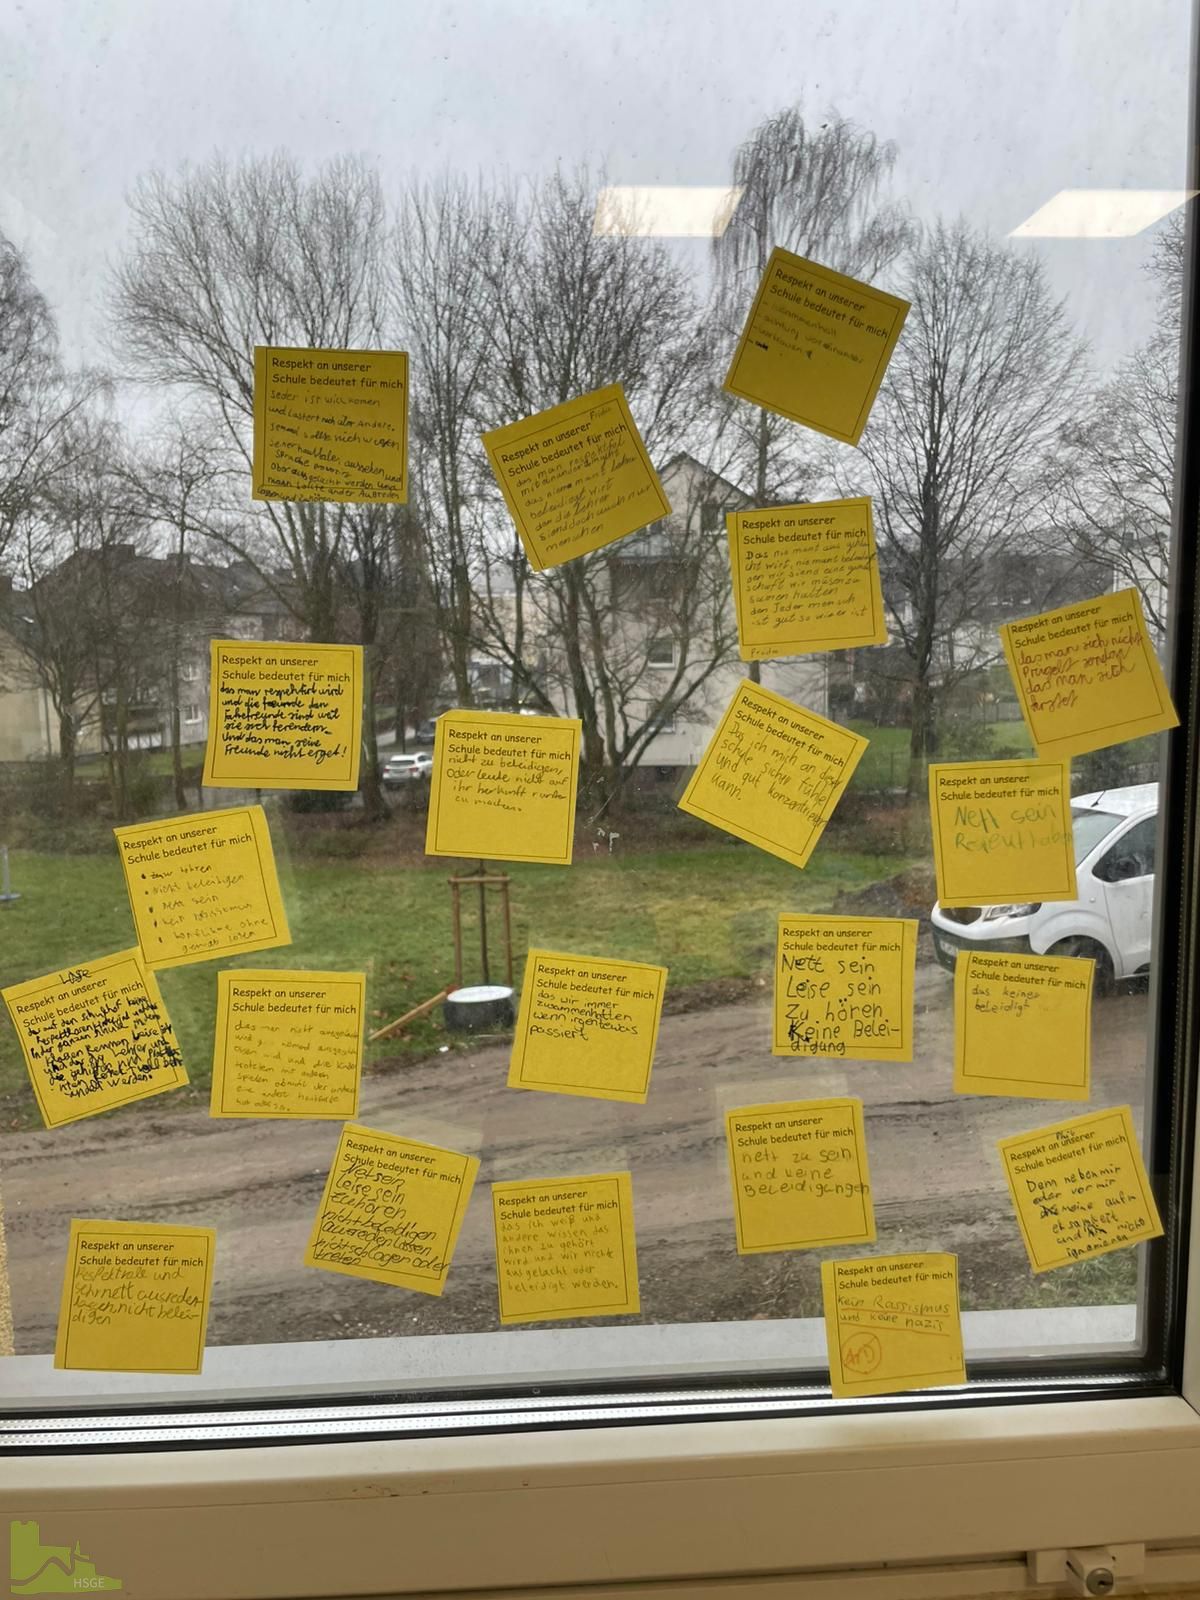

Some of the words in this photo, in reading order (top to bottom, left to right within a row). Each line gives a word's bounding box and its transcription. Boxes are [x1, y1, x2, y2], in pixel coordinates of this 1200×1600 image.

[775, 269, 813, 290] Respekt
[816, 287, 827, 298] an
[829, 292, 865, 311] unserer
[770, 284, 802, 304] Schule
[803, 298, 847, 321] bedeutet
[848, 316, 864, 329] für
[866, 324, 888, 338] mich
[272, 357, 313, 370] Respekt
[332, 363, 371, 371] unserer
[272, 373, 306, 385] Schule
[310, 376, 356, 386] bedeutet
[361, 378, 377, 387] für
[380, 379, 403, 389] mich
[501, 442, 539, 462] Respekt
[543, 436, 554, 448] an
[556, 422, 591, 442] unserer
[508, 458, 544, 476] Schule
[541, 441, 584, 464] bedeutet
[586, 432, 602, 445] für
[605, 424, 626, 438] mich
[742, 517, 780, 531] Respekt
[784, 518, 795, 526] an
[798, 517, 835, 526] unserer
[743, 533, 775, 544] Schule
[778, 531, 822, 542] bedeutet
[826, 531, 842, 540] für
[844, 528, 866, 539] mich
[1012, 618, 1048, 633] Respekt
[1051, 615, 1063, 624] an
[1065, 607, 1101, 620] unserer
[1015, 635, 1046, 648] Schule
[1048, 625, 1091, 640] bedeutet
[1094, 620, 1109, 630] für
[1111, 612, 1133, 625] mich
[222, 655, 262, 666] Respekt
[280, 658, 318, 666] unserer
[222, 671, 255, 680] Schule
[259, 672, 304, 681] bedeutet
[309, 672, 324, 682] für
[327, 673, 350, 682] mich
[741, 696, 777, 720] Respekt
[778, 715, 789, 725] an
[790, 720, 825, 741] unserer
[449, 729, 488, 741] Respekt
[505, 735, 542, 744] unserer
[735, 710, 764, 729] Schule
[766, 724, 806, 748] bedeutet
[807, 744, 823, 758] für
[824, 752, 845, 767] mich
[448, 745, 480, 754] Schule
[483, 747, 527, 758] bedeutet
[531, 750, 546, 758] für
[549, 751, 570, 760] mich
[940, 777, 976, 787] Respekt
[993, 775, 1029, 784] unserer
[940, 791, 972, 800] Schule
[974, 789, 1017, 799] bedeutet
[1020, 788, 1034, 797] für
[1038, 786, 1059, 796] mich
[1010, 802, 1056, 823] sein
[123, 836, 162, 850] Respekt
[166, 833, 178, 842] an
[180, 826, 218, 840] unserer
[127, 852, 160, 864] Schule
[162, 843, 207, 858] bedeutet
[210, 838, 226, 849] für
[229, 834, 252, 845] mich
[783, 928, 820, 938] Respekt
[783, 942, 813, 950] Schule
[816, 942, 858, 951] bedeutet
[862, 943, 876, 951] für
[880, 943, 900, 951] mich
[782, 954, 825, 973] Nett
[838, 956, 875, 974] sein
[972, 956, 1008, 968] Respekt
[1024, 963, 1060, 972] unserer
[538, 964, 575, 977] Respekt
[578, 970, 588, 978] an
[591, 973, 627, 982] unserer
[970, 970, 1000, 980] Schule
[1003, 974, 1045, 985] bedeutet
[1048, 978, 1062, 986] für
[1064, 980, 1086, 990] mich
[232, 988, 272, 998] Respekt
[536, 979, 568, 990] Schule
[570, 982, 613, 994] bedeutet
[616, 988, 631, 997] für
[632, 990, 655, 999] mich
[786, 975, 830, 999] Leise
[847, 976, 881, 997] sein
[232, 1003, 265, 1012] Schule
[268, 1003, 312, 1013] bedeutet
[316, 1004, 330, 1014] für
[334, 1005, 356, 1014] mich
[561, 995, 579, 1004] wir
[584, 999, 620, 1009] immer
[825, 998, 883, 1021] hören
[533, 1012, 566, 1020] wenn
[735, 1121, 771, 1133] Respekt
[774, 1120, 786, 1128] an
[788, 1117, 823, 1127] unserer
[737, 1136, 768, 1147] Schule
[771, 1132, 812, 1143] bedeutet
[815, 1130, 830, 1138] für
[833, 1128, 853, 1138] mich
[742, 1149, 778, 1163] nett
[792, 1152, 810, 1163] zu
[820, 1147, 852, 1163] sein
[499, 1195, 535, 1206] Respekt
[538, 1194, 549, 1202] an
[552, 1190, 588, 1201] unserer
[500, 1210, 531, 1220] Schule
[534, 1205, 576, 1216] bedeutet
[579, 1202, 595, 1211] für
[597, 1200, 617, 1210] mich
[81, 1241, 120, 1252] Respekt
[79, 1256, 112, 1265] Schule
[115, 1257, 160, 1266] bedeutet
[163, 1257, 179, 1266] für
[181, 1257, 203, 1267] mich
[837, 1266, 873, 1276] Respekt
[839, 1279, 868, 1289] Schule
[871, 1276, 912, 1286] bedeutet
[915, 1273, 929, 1281] für
[932, 1272, 953, 1280] mich
